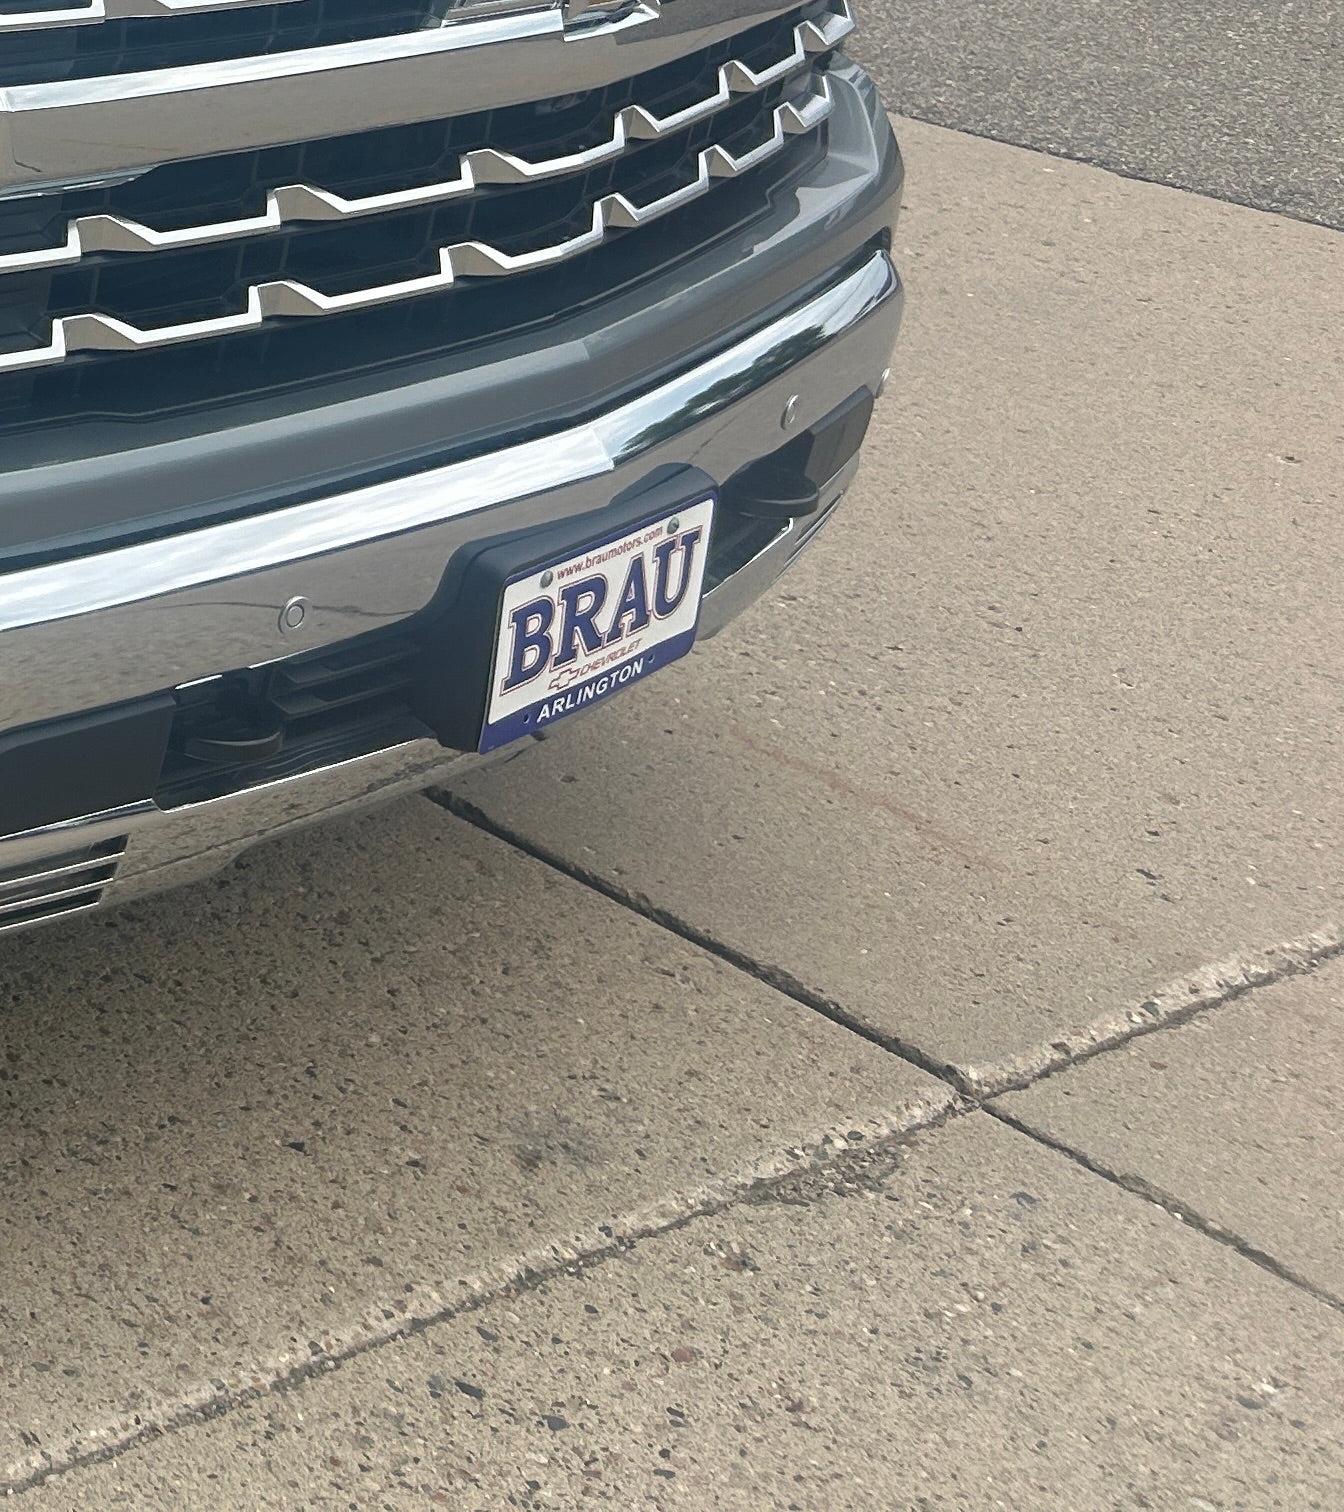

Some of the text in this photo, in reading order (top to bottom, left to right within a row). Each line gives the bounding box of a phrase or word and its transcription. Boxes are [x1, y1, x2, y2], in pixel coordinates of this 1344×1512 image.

[556, 526, 664, 580] www.braumotors.com
[499, 525, 703, 696] BRAU
[578, 638, 642, 677] CHEVROLET
[536, 657, 644, 724] ARLINGTON
